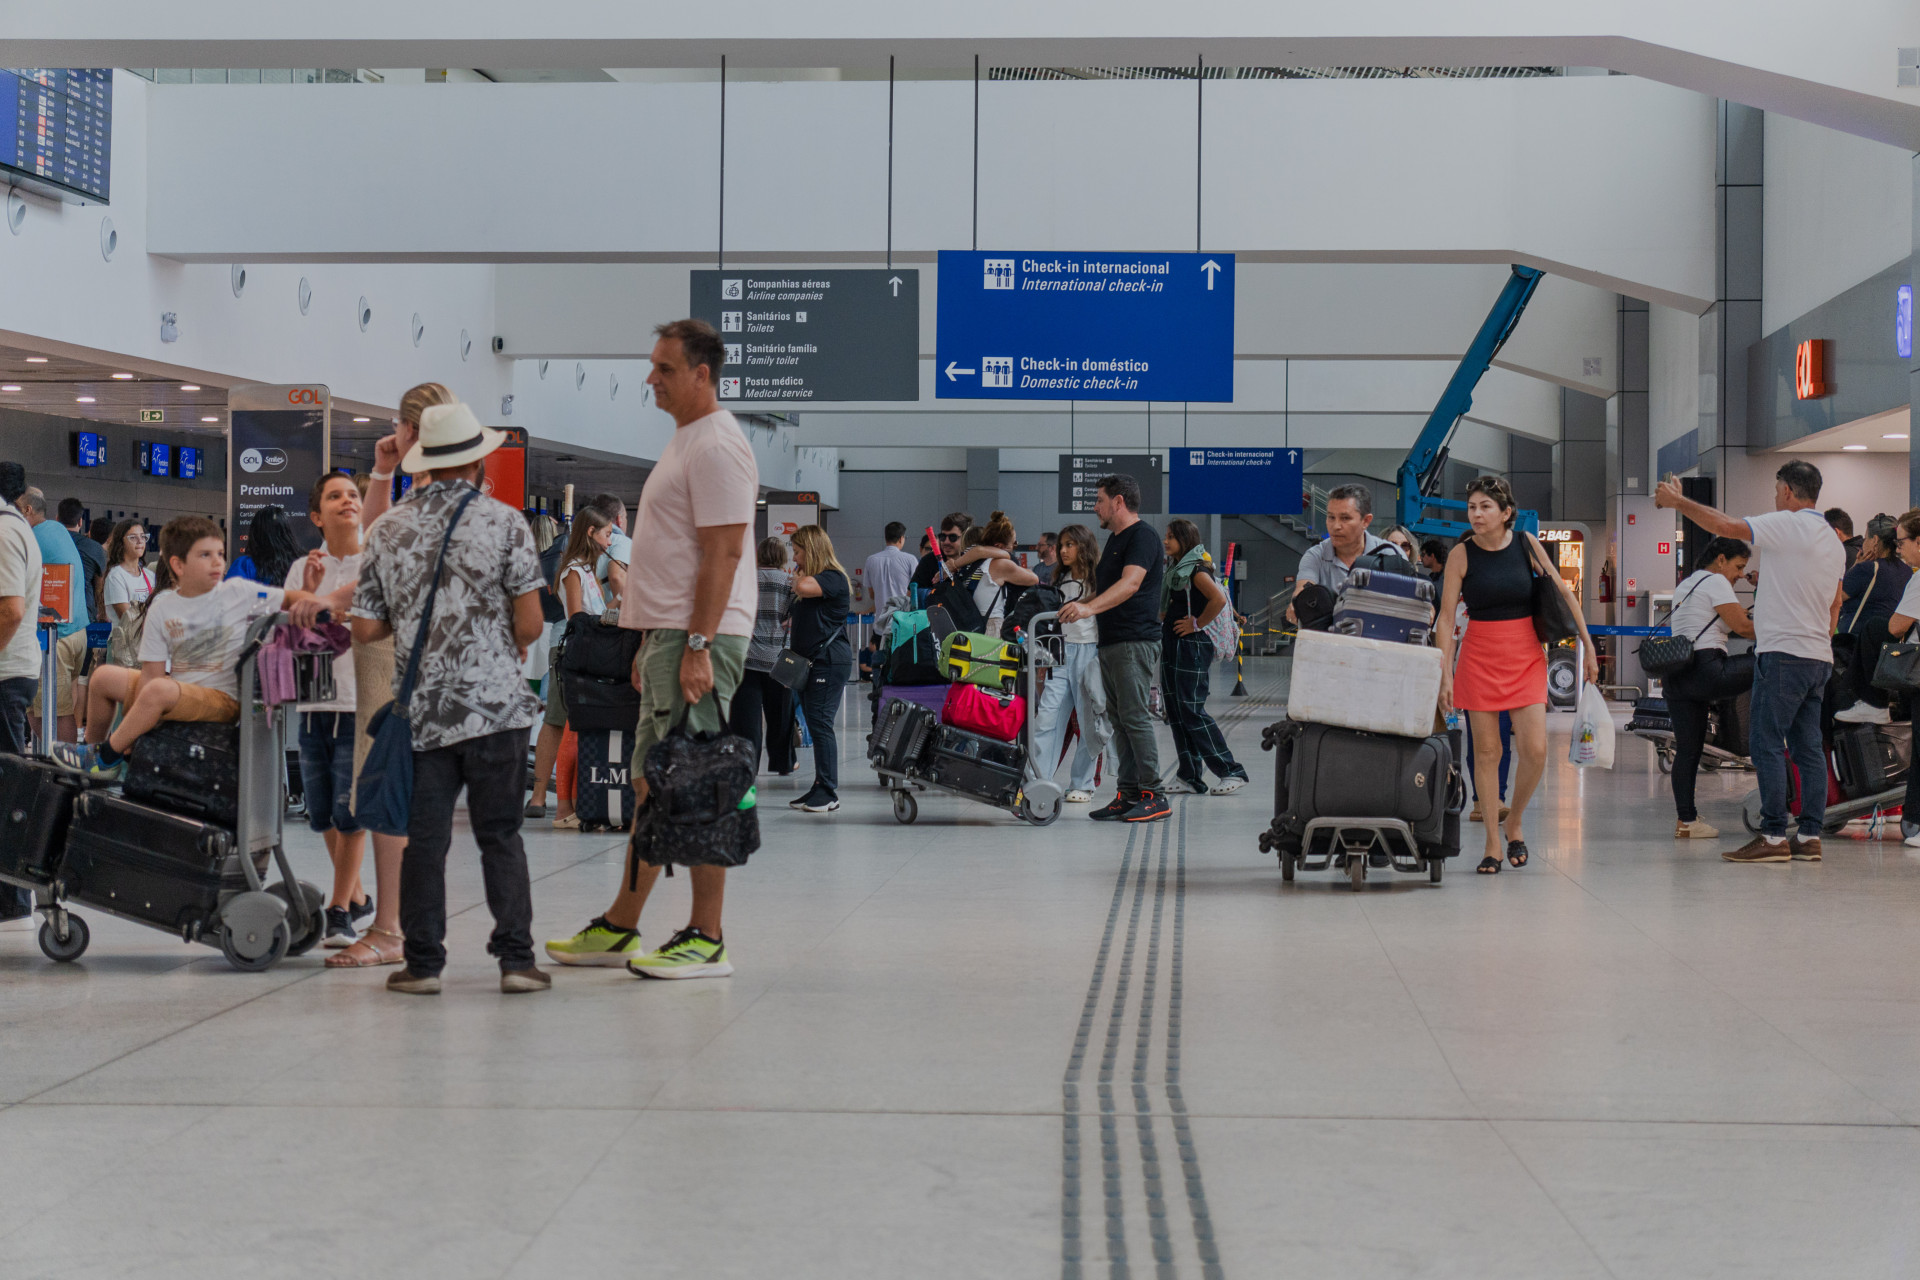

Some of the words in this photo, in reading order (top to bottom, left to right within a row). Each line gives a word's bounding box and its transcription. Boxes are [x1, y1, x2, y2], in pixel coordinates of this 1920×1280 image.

[1022, 259, 1079, 274] Check-in
[1083, 260, 1170, 275] internacional
[747, 279, 800, 290] Companhias
[802, 280, 831, 289] aéreas
[1022, 277, 1105, 292] International
[1108, 279, 1163, 293] check-in
[747, 291, 775, 300] Airline
[777, 292, 823, 302] companies
[746, 311, 791, 321] Sanitários
[747, 324, 774, 333] Toilets
[746, 344, 786, 353] Sanitário
[788, 344, 818, 353] família
[746, 356, 774, 366] Family
[776, 356, 799, 365] toilet
[1020, 357, 1078, 371] Check-in
[1081, 358, 1149, 372] doméstico
[1796, 339, 1818, 400] GOL
[745, 377, 770, 386] Posto
[771, 377, 804, 386] médico
[1020, 375, 1080, 389] Domestic
[1083, 376, 1138, 390] check-in
[288, 389, 324, 404] GOL
[745, 389, 780, 398] Medical
[781, 389, 813, 398] service
[505, 431, 524, 443] OL
[98, 447, 105, 462] 42
[141, 452, 147, 467] 43
[243, 456, 259, 464] GOL
[240, 484, 294, 496] Premium
[1547, 530, 1571, 541] BAG
[1660, 543, 1668, 553] H
[590, 766, 628, 785] L.M
